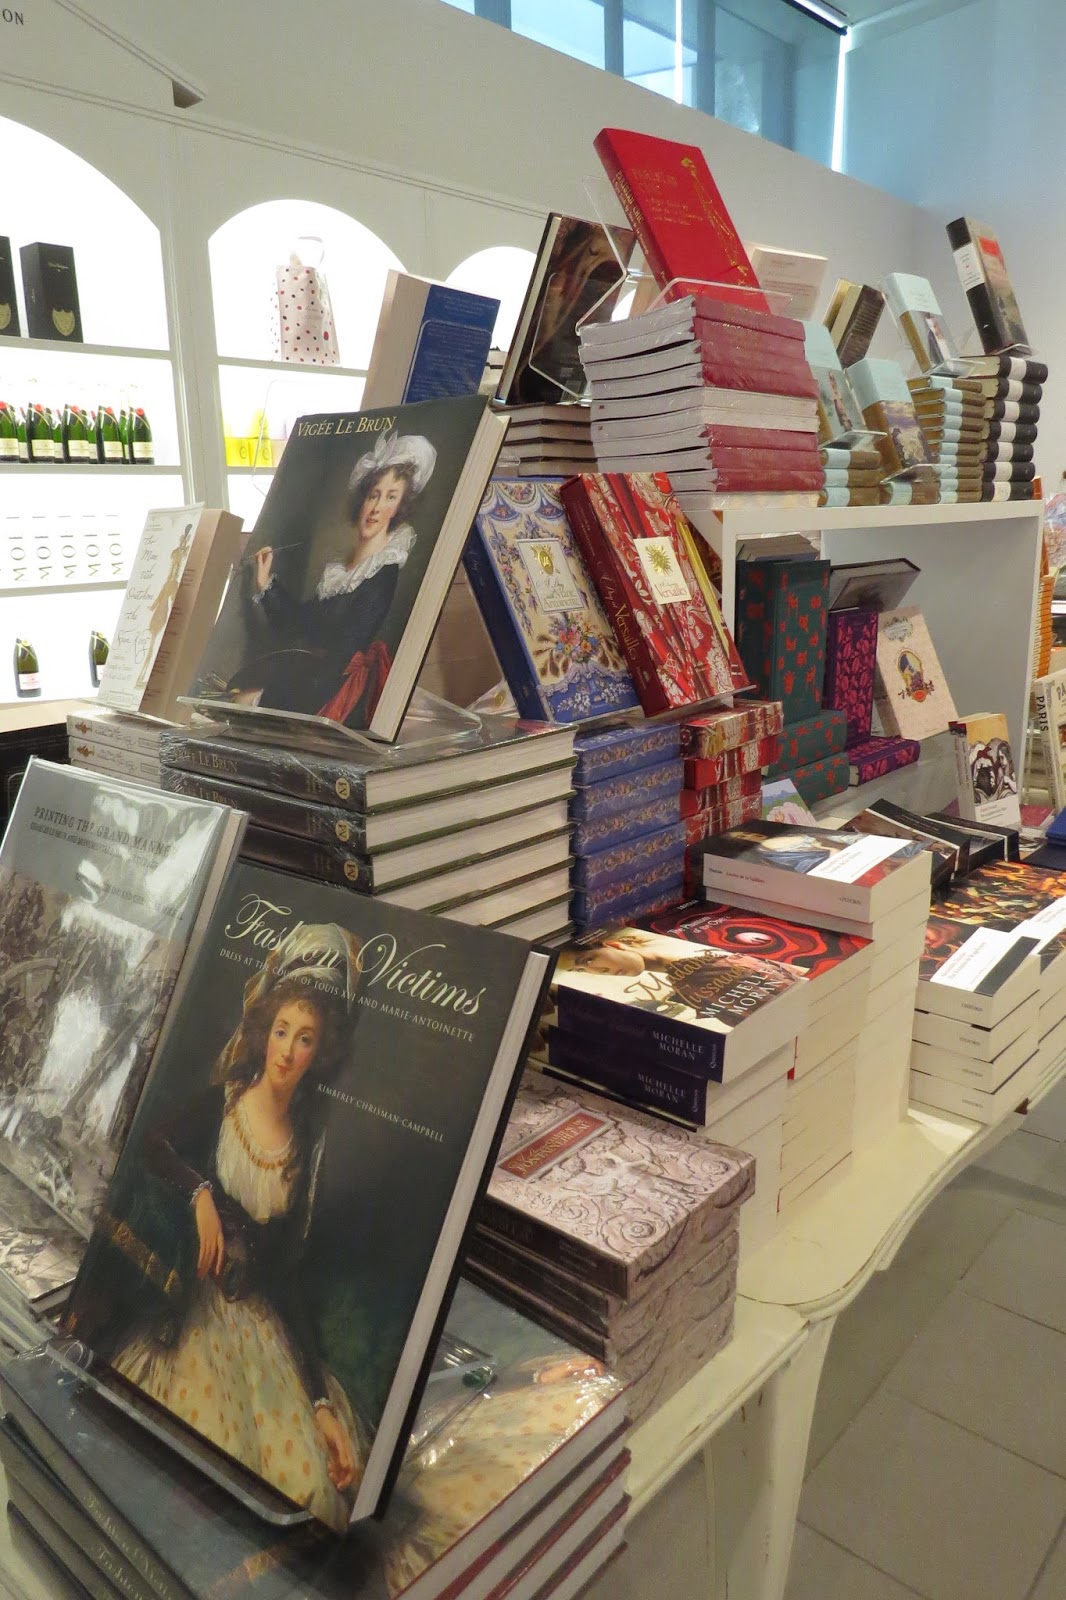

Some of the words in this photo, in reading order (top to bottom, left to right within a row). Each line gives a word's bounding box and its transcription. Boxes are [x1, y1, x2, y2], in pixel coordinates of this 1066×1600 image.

[297, 419, 335, 437] VIGÉE
[356, 416, 398, 434] BRUN
[1036, 695, 1049, 732] PARIS
[34, 806, 76, 828] PRINTING
[96, 825, 130, 845] GRAND
[225, 893, 342, 969] Fashion
[356, 932, 486, 1015] Victims
[220, 948, 242, 962] DRESS
[243, 956, 253, 966] AT
[255, 959, 270, 971] THE
[272, 966, 299, 981] COURT
[301, 976, 312, 986] OF
[314, 980, 338, 996] LOUIS
[341, 989, 356, 1002] XVI
[358, 996, 378, 1009] AND
[380, 1003, 475, 1042] MARIE-ANTOINETTE
[700, 960, 774, 1018] MICHELLE
[726, 978, 784, 1016] MORAN
[652, 1031, 704, 1054] MICHELLE
[659, 1041, 696, 1061] MORAN
[318, 1083, 355, 1104] KIMBERLY
[637, 1072, 686, 1097] MICHELLE
[644, 1084, 679, 1104] MORAN
